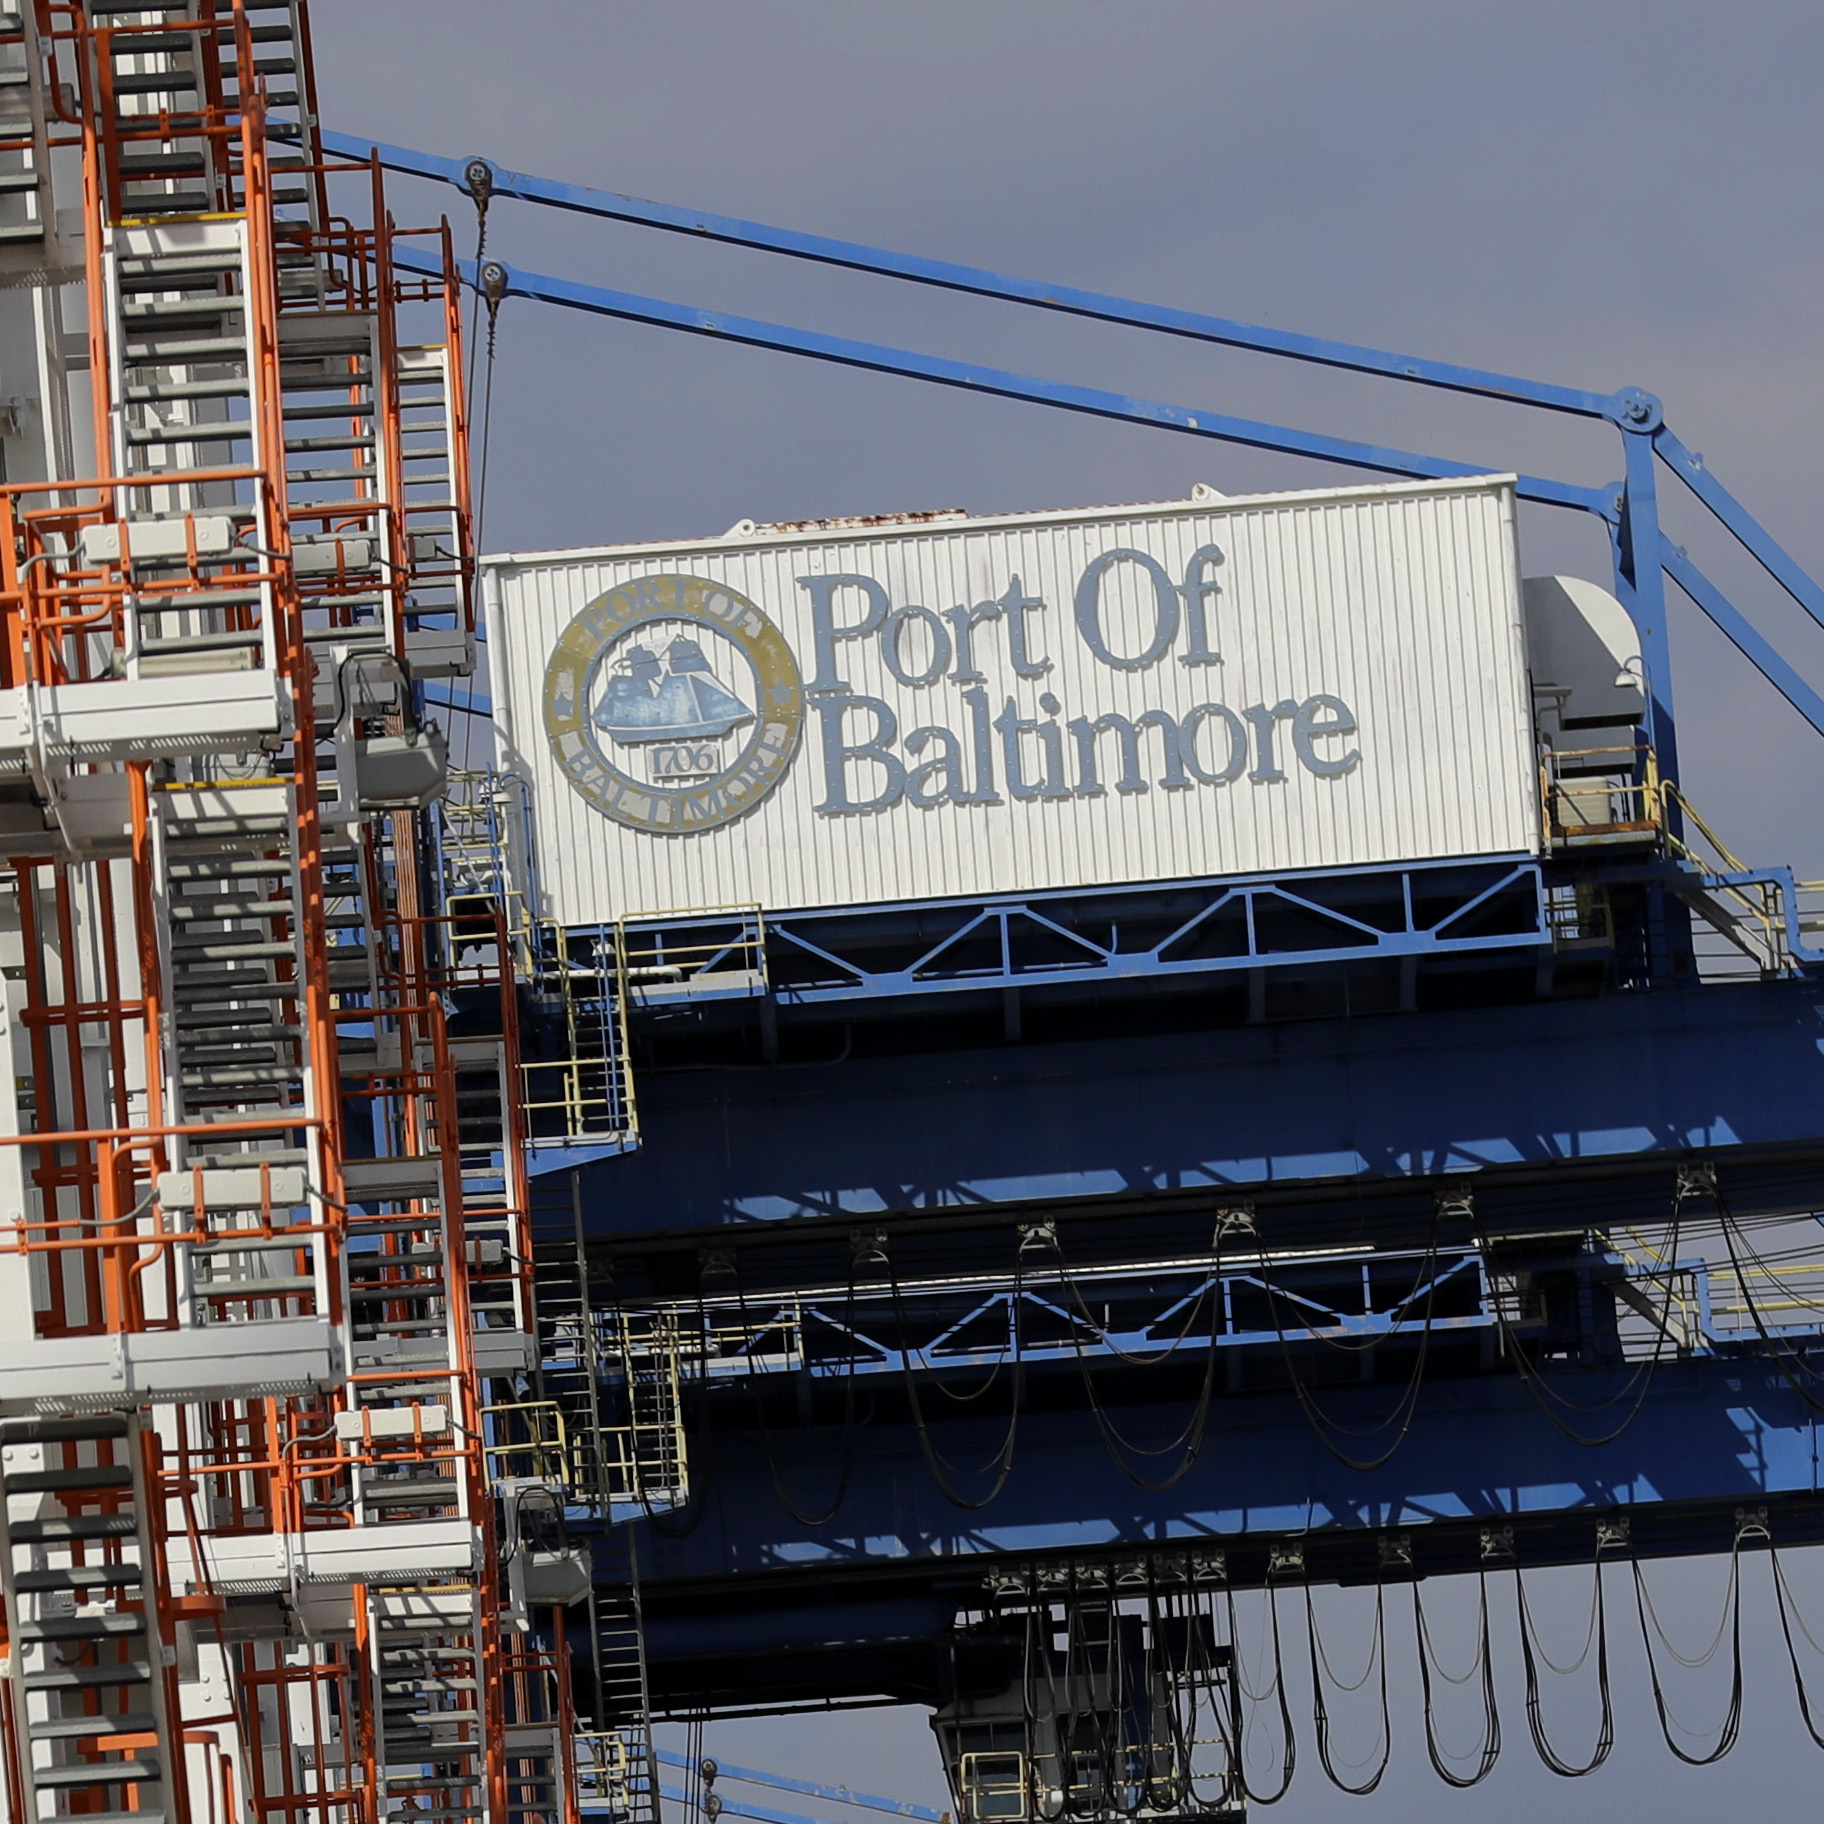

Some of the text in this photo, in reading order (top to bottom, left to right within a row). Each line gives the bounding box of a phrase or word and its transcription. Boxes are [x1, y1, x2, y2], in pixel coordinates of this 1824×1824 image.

[579, 577, 696, 642] PORT
[797, 543, 1224, 693] Port Of
[564, 725, 790, 828] BALTIMORE
[652, 744, 715, 775] 1706
[806, 684, 1362, 816] Baltimore
